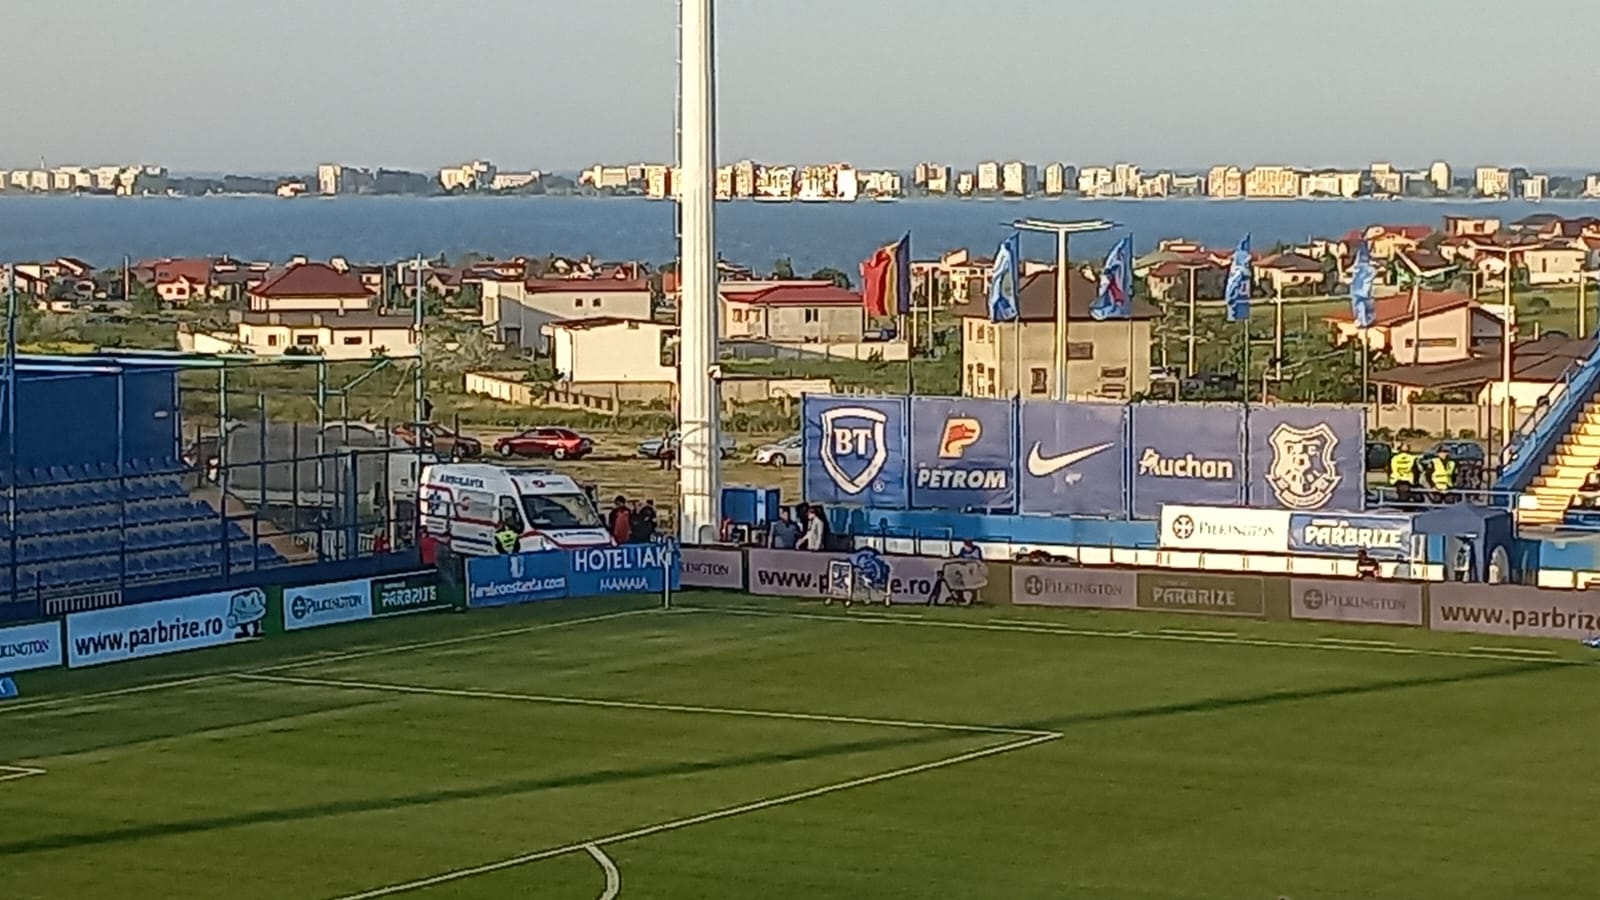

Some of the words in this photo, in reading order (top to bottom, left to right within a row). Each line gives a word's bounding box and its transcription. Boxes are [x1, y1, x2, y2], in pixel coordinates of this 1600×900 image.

[834, 428, 873, 456] BT
[1139, 448, 1234, 479] Auchan
[916, 470, 1006, 489] PETROM
[1304, 526, 1402, 548] PARBRIZE
[574, 547, 632, 572] HOTEL
[599, 577, 649, 592] MAMAIA
[1044, 578, 1122, 597] PILKINGTON
[305, 594, 362, 614] PILKINGTON
[1153, 587, 1236, 606] PARBRIZE
[1325, 590, 1406, 611] PILKINGTON
[75, 615, 223, 656] www.parbrize.ro
